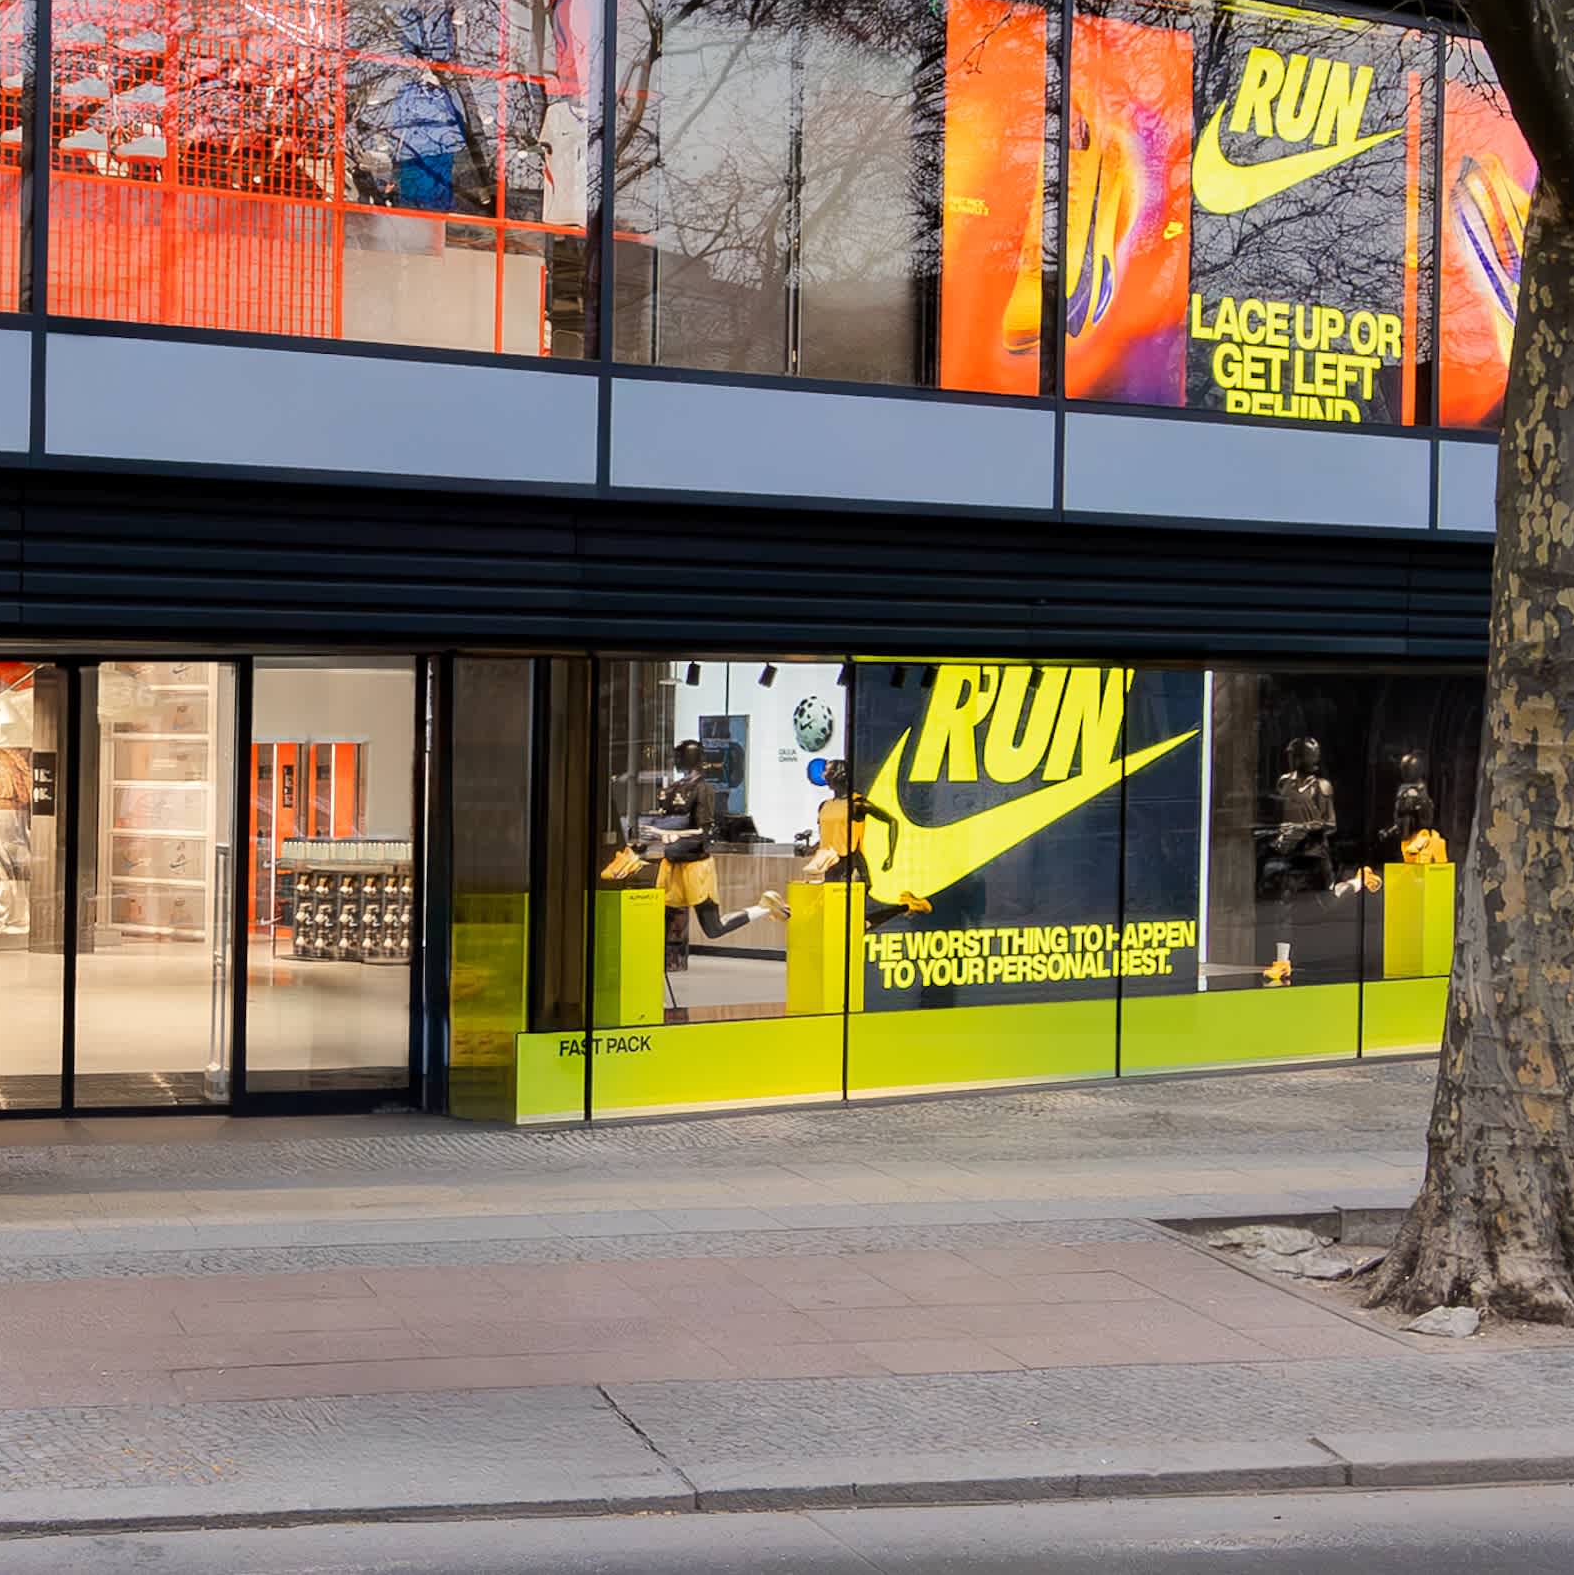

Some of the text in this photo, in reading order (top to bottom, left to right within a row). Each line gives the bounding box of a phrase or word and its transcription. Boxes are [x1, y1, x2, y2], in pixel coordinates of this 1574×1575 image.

[1229, 45, 1374, 147] RUN
[1191, 293, 1402, 358] LACE UP OR
[1212, 342, 1382, 401] GET LEFT
[908, 664, 1136, 784] RUN
[864, 920, 1196, 963] THE WORST THING TO HAPPEN
[878, 947, 1174, 989] TO YOUR PERSONAL BEST.
[605, 1034, 652, 1055] PACK
